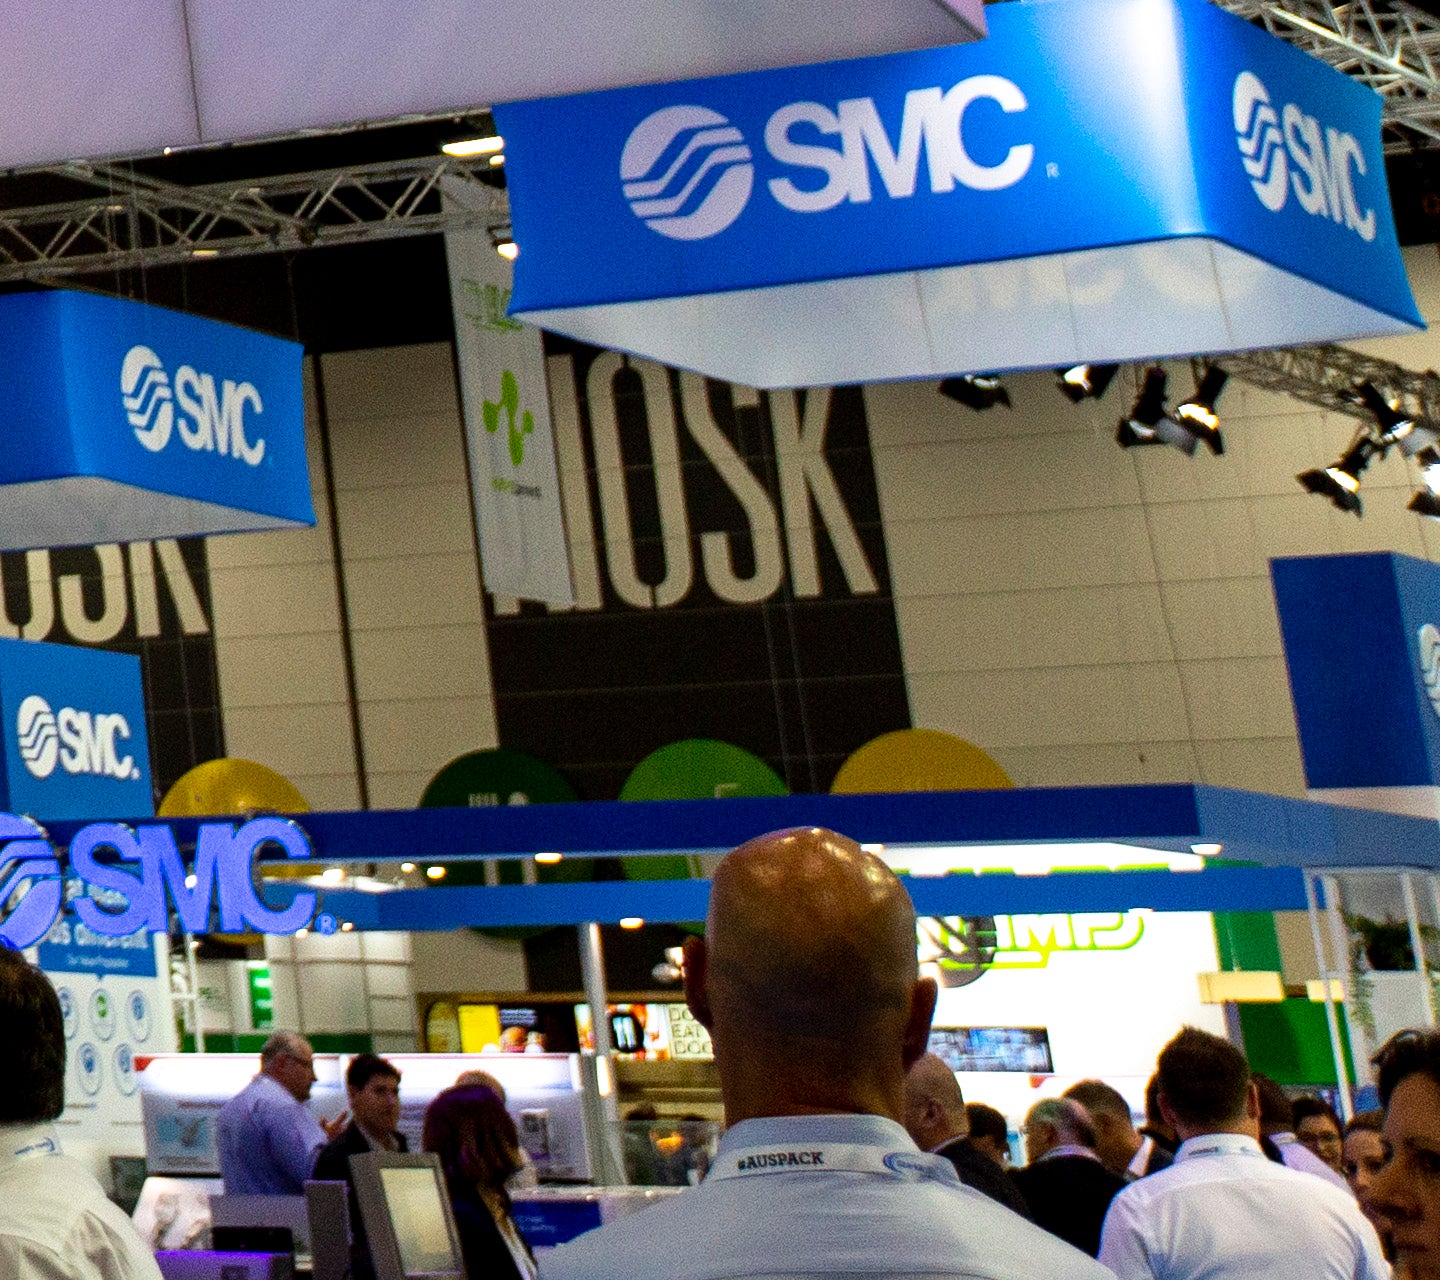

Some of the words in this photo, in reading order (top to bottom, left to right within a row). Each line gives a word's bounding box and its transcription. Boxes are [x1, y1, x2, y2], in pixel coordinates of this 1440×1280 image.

[765, 73, 1034, 213] SMC
[1282, 102, 1377, 243] SMC
[175, 363, 266, 467] SMC
[55, 706, 135, 779] SMC
[69, 816, 318, 937] SMC
